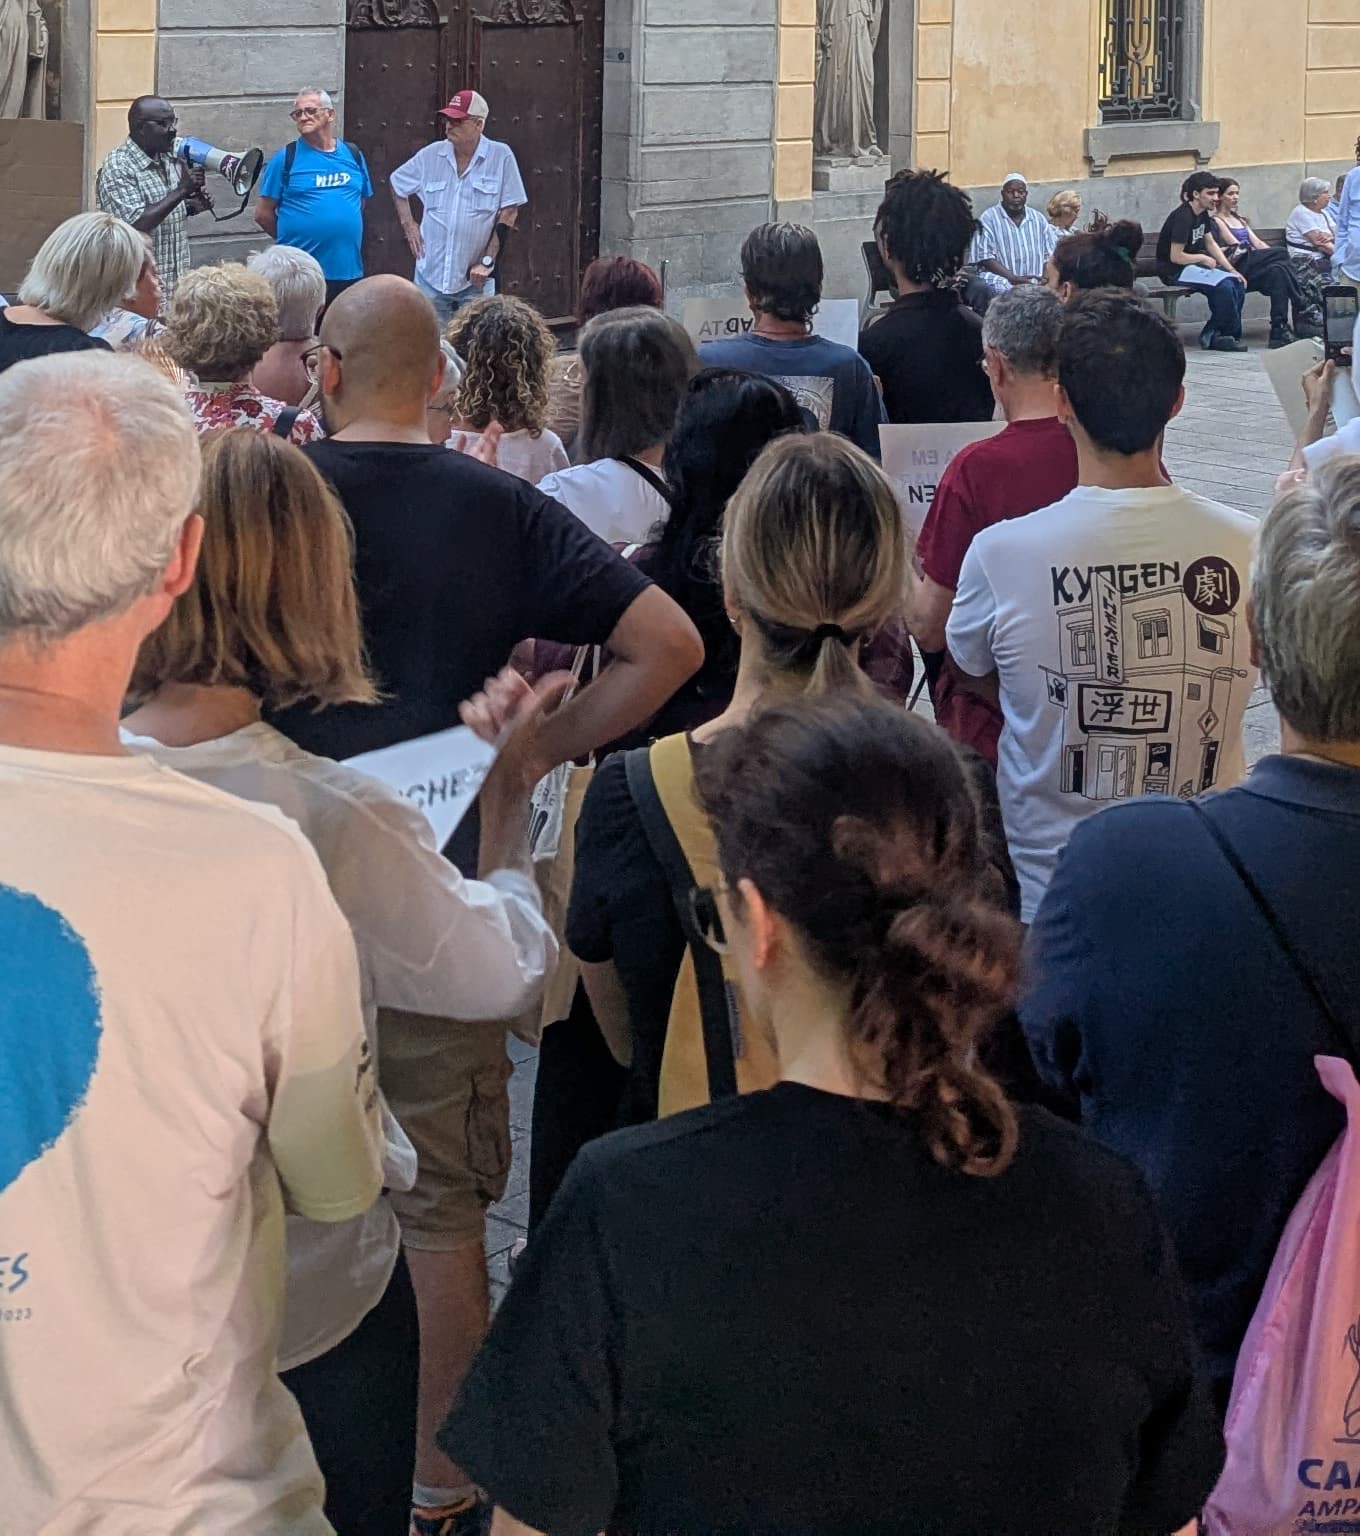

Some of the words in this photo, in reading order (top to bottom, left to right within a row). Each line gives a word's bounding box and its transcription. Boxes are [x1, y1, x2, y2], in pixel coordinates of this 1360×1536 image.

[1051, 561, 1180, 606] KYOGEN
[1193, 566, 1232, 607] 劇
[1103, 583, 1122, 680] THEATER
[1089, 690, 1161, 725] 浮世
